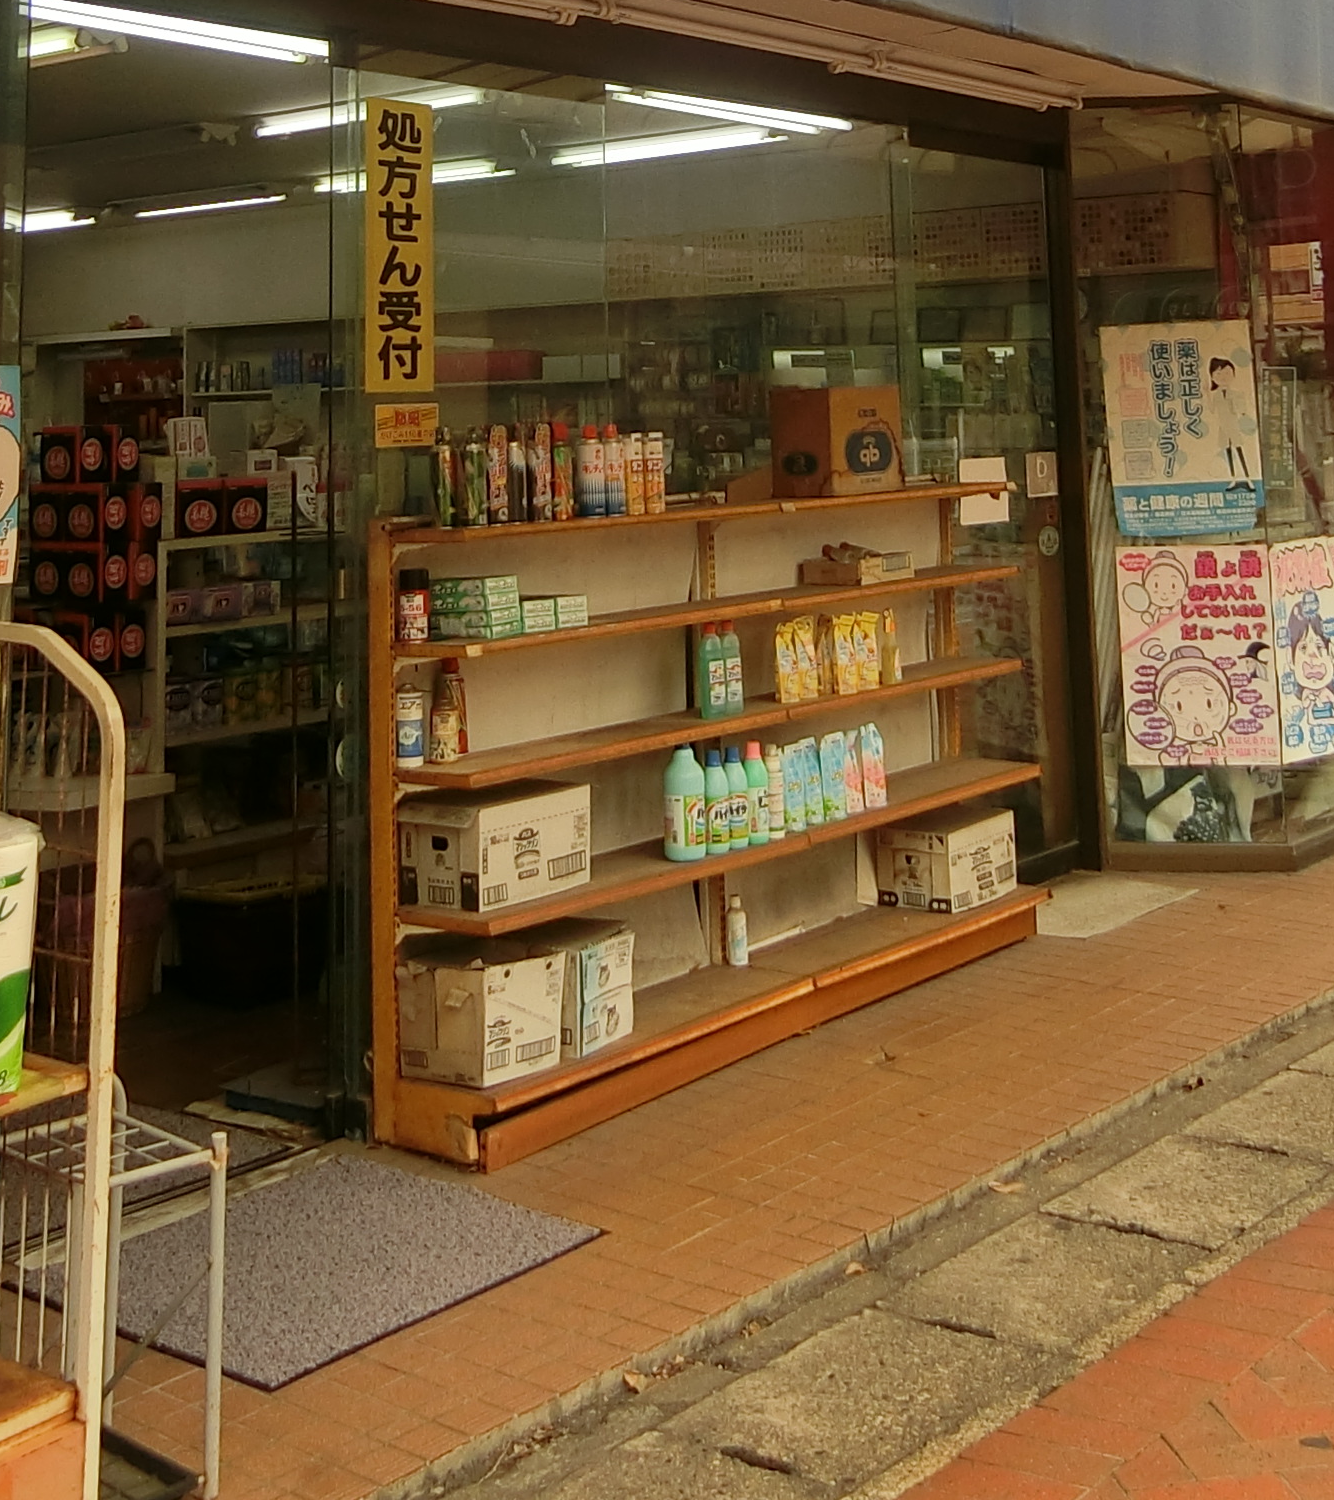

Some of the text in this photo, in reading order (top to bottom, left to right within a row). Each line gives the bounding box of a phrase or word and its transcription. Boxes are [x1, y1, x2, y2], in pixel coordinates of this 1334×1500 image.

[376, 108, 423, 381] 処方せん受付
[1175, 338, 1202, 439] 薬は正しく
[1180, 604, 1265, 619] してないのは
[1187, 584, 1256, 602] お手入れ
